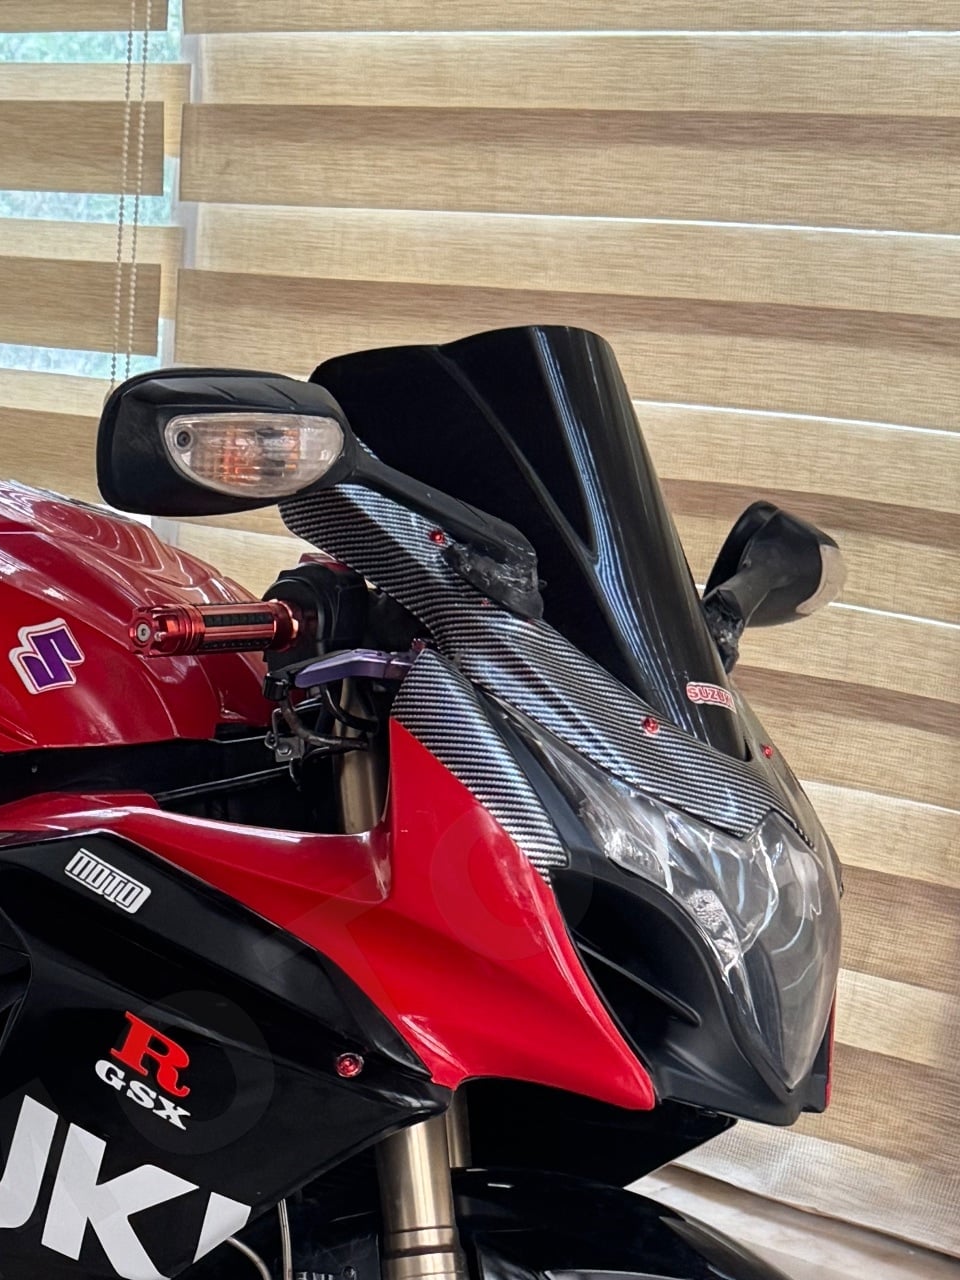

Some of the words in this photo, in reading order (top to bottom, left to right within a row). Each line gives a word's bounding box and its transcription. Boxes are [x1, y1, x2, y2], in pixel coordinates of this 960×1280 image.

[65, 849, 148, 910] MOTO
[109, 1010, 191, 1098] R
[95, 1059, 192, 1131] GSX
